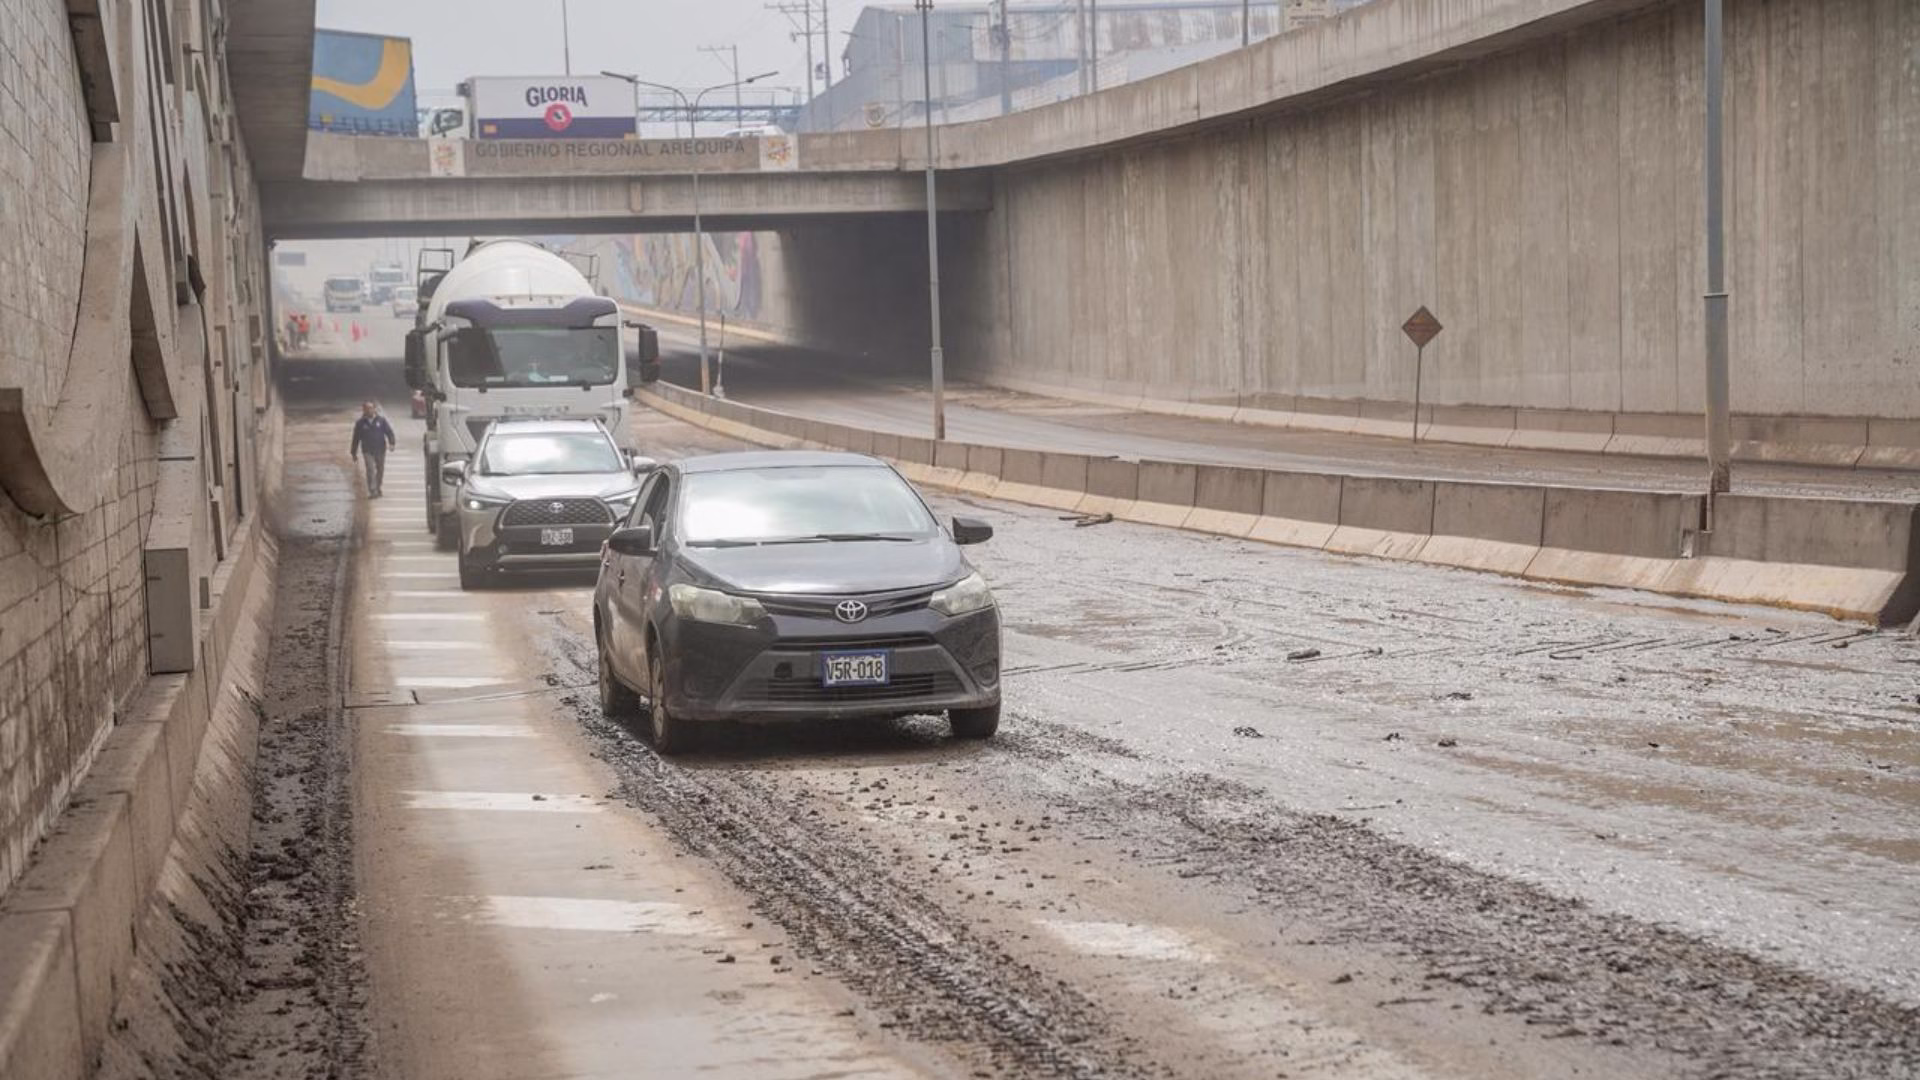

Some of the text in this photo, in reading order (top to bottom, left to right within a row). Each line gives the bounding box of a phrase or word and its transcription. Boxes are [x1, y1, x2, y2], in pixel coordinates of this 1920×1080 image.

[526, 86, 588, 107] GLORIA
[475, 139, 745, 158] GOBIERNO REGIONAL AREQUIPA
[826, 660, 884, 680] V5R-018
